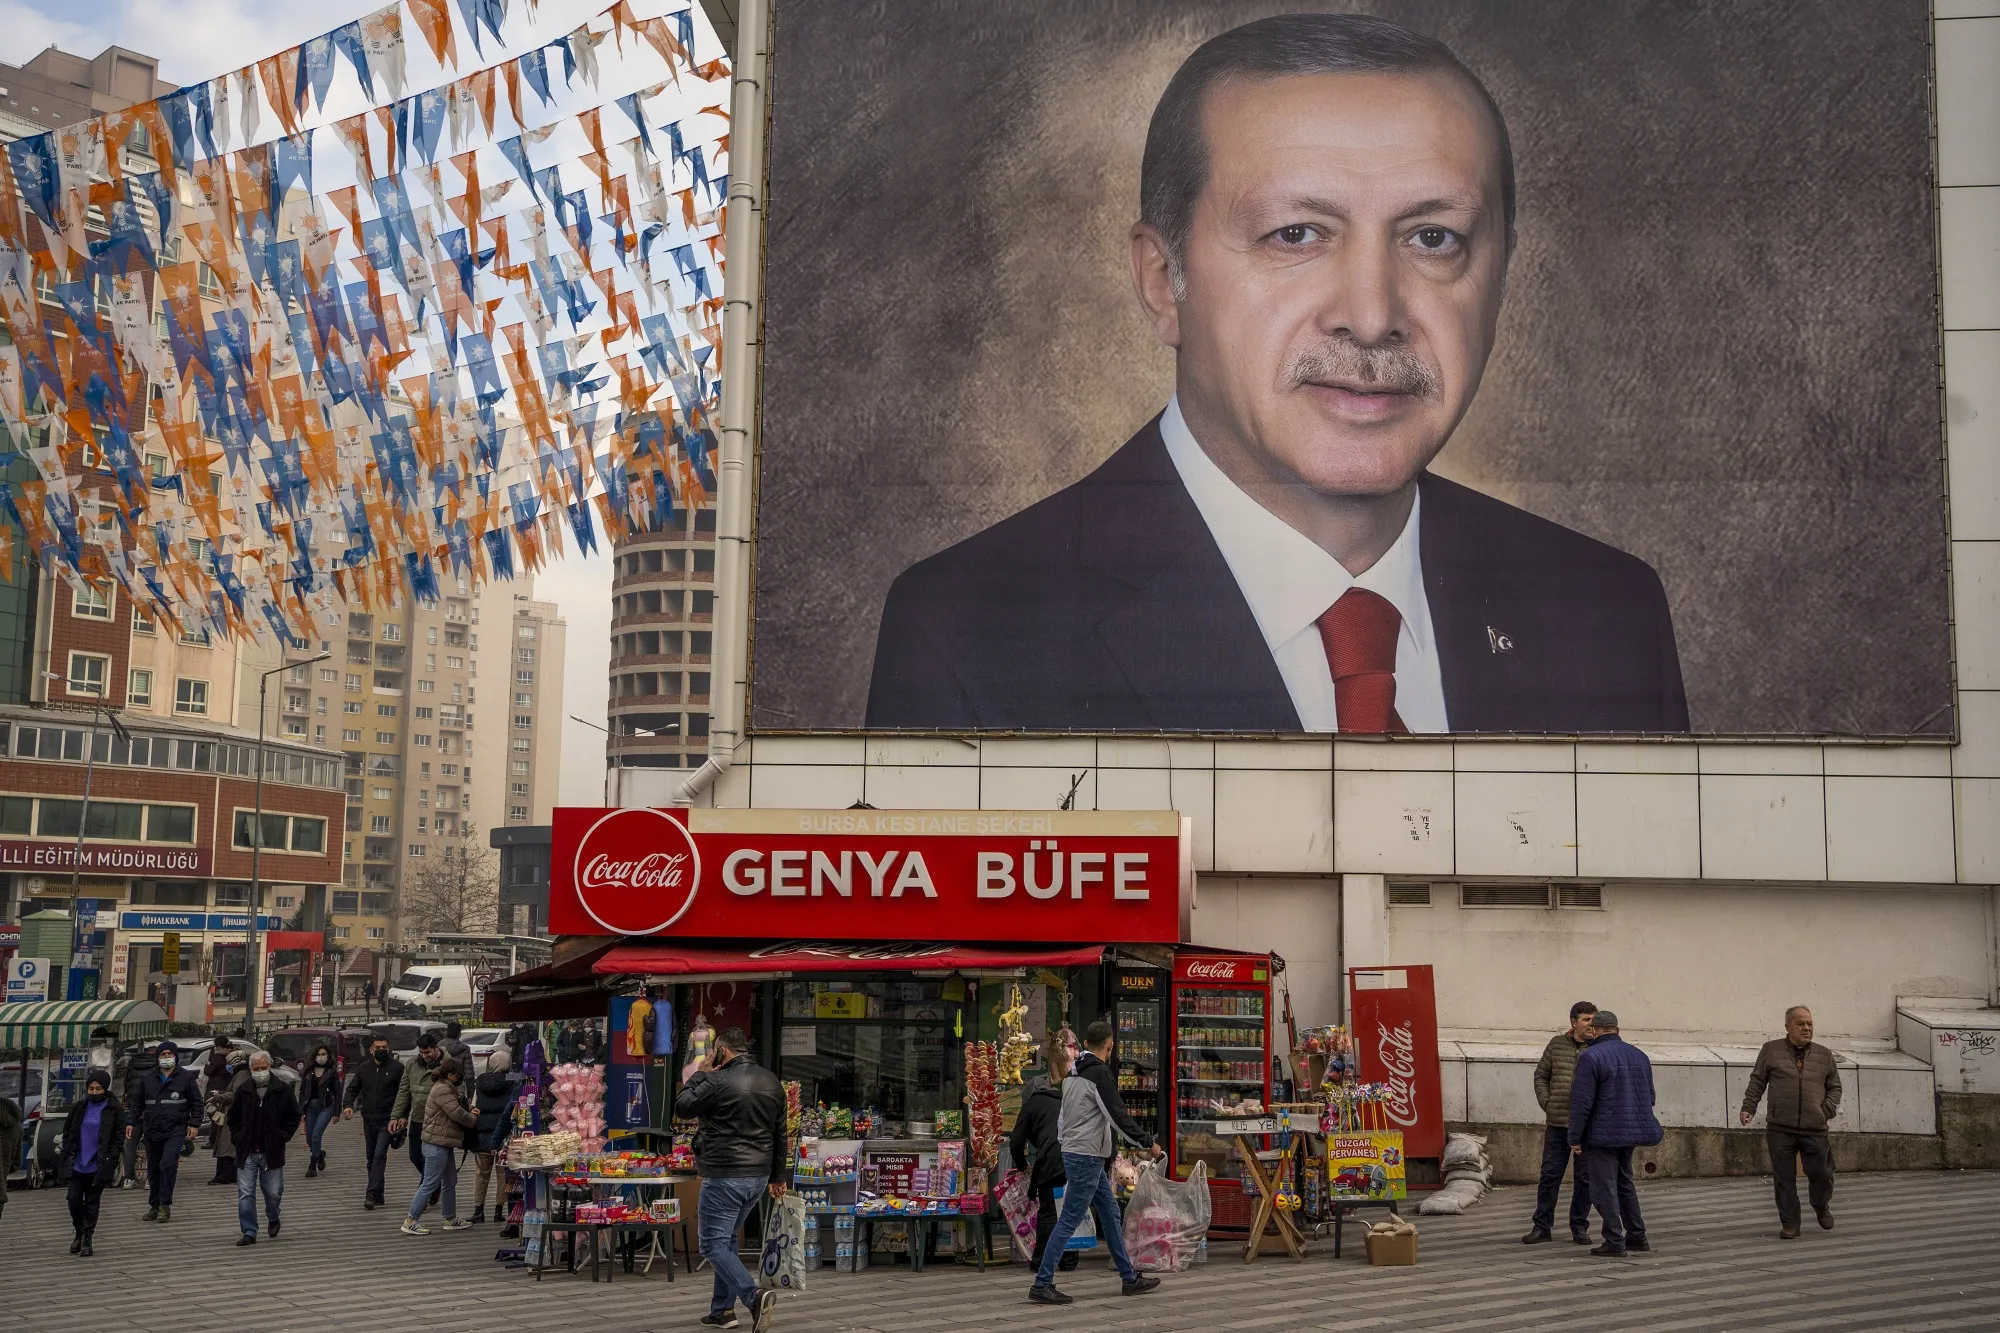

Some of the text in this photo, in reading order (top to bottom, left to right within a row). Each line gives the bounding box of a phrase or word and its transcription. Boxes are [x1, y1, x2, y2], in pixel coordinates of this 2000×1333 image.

[800, 813, 1052, 835] BURSA KESTANE ŞEKERİ
[0, 846, 199, 870] LLİ EĞİTİM MÜDÜRLÜĞÜ
[582, 853, 682, 888] Coca-Cola
[722, 840, 1150, 900] GENYA BÜFE
[150, 917, 190, 925] HALKBANK
[1187, 961, 1237, 979] Coca-Cola
[1121, 976, 1154, 987] BURN
[64, 1053, 84, 1062] SOĞUK
[1378, 1021, 1418, 1127] Coca-Cola
[1335, 1138, 1370, 1148] RÜZGAR
[1330, 1148, 1378, 1160] PERVANESİ
